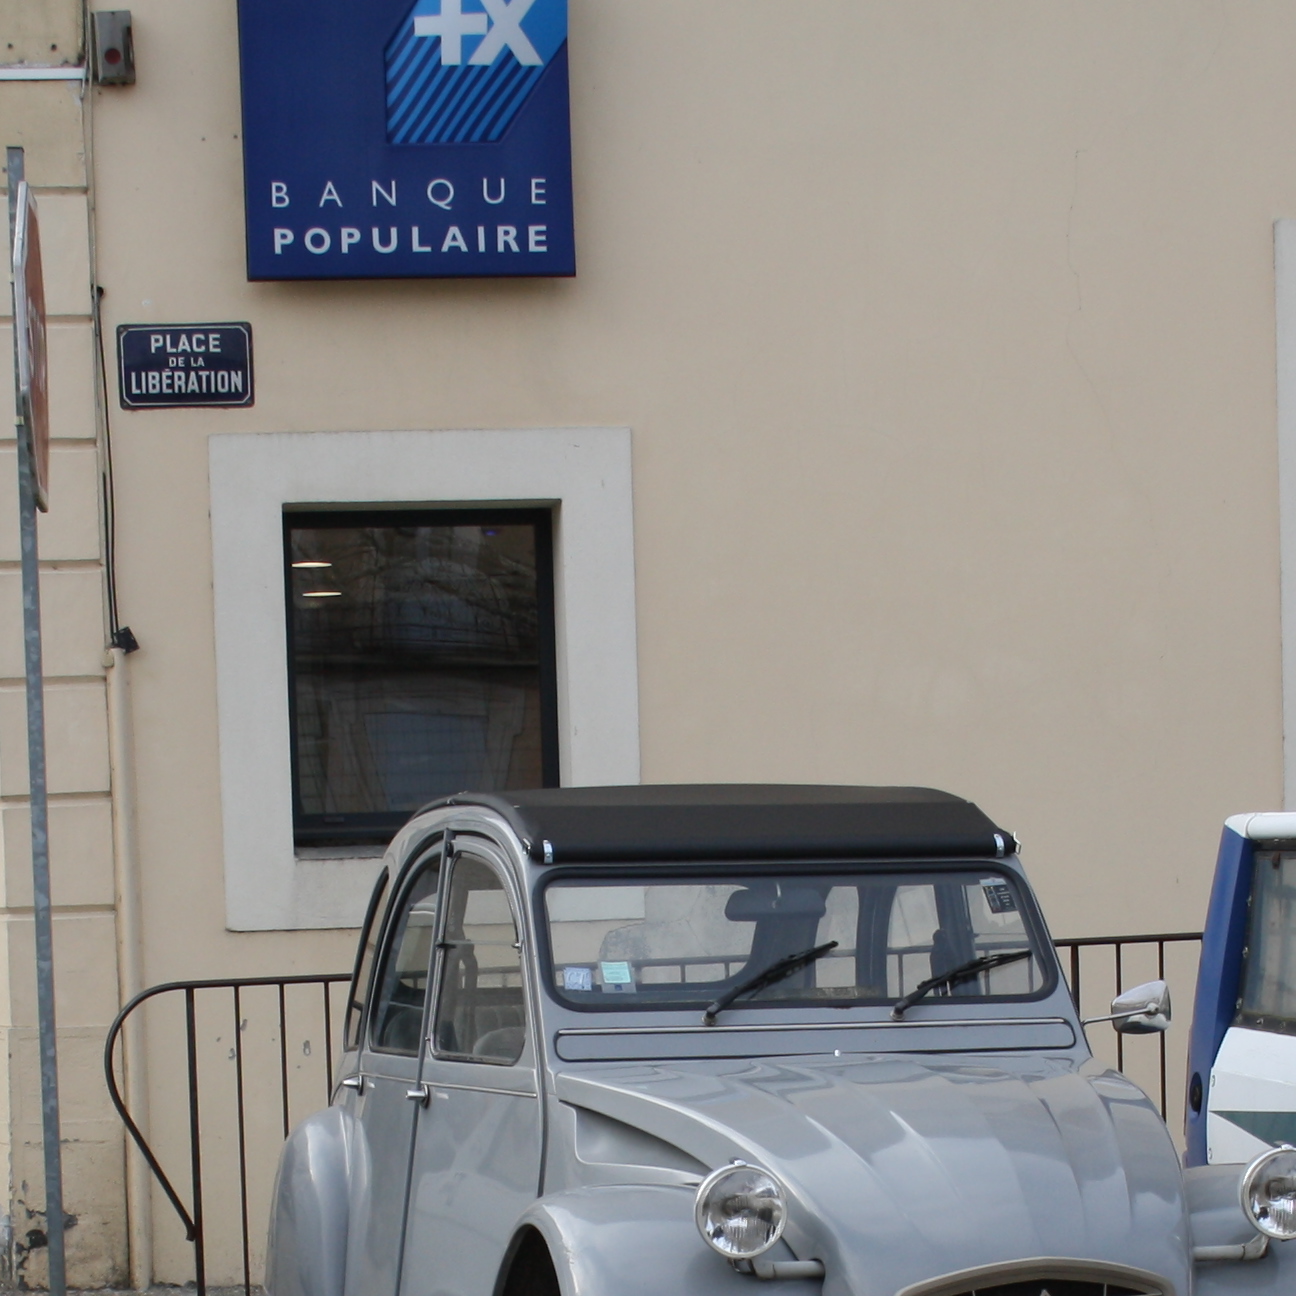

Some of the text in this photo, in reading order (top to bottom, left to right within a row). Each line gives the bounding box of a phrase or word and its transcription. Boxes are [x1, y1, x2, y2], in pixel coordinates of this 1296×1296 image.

[271, 178, 547, 210] BANQUE
[273, 225, 548, 254] POPULAIRE
[150, 333, 222, 353] PLACE
[168, 357, 205, 367] DE LA
